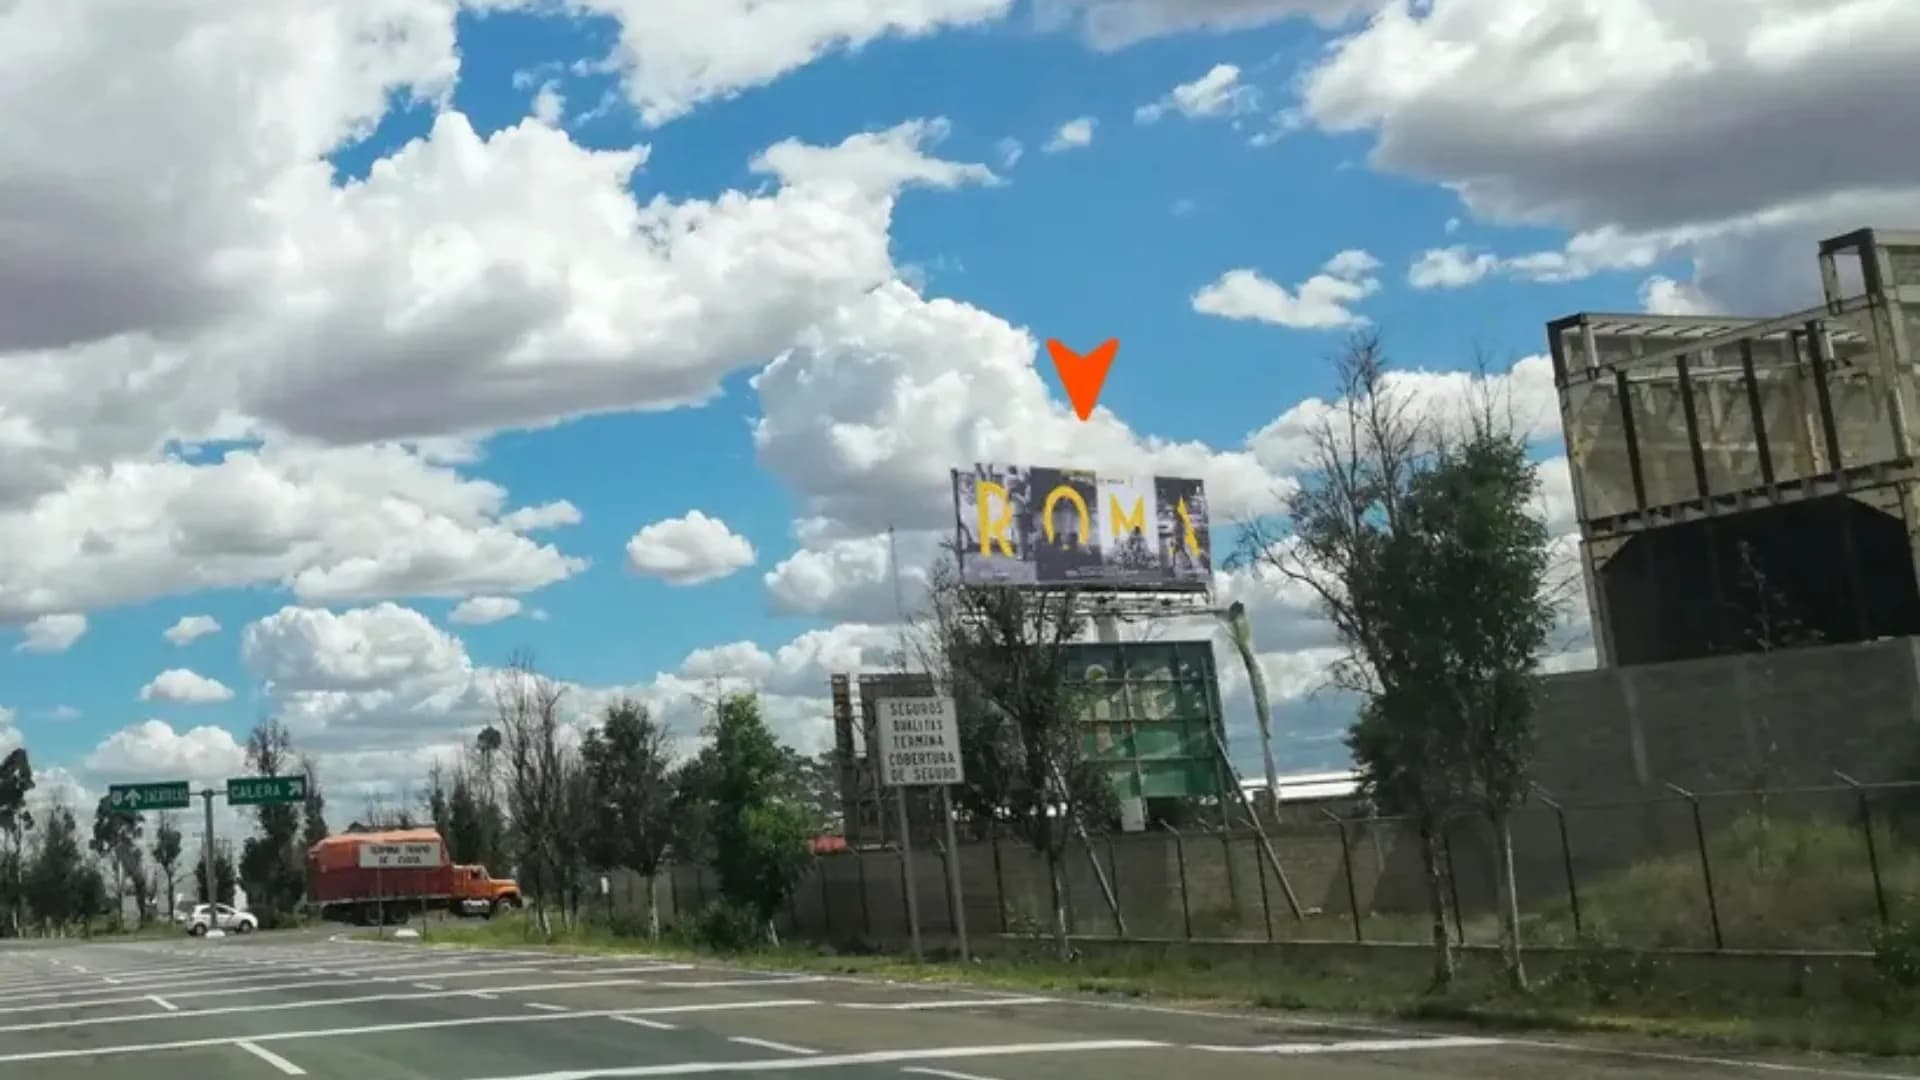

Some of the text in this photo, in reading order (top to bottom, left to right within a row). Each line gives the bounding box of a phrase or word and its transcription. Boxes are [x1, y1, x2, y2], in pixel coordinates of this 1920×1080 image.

[890, 702, 943, 717] SEGUROS
[893, 735, 944, 749] TERMINA
[888, 751, 955, 767] COBERTURA
[891, 766, 957, 782] DE SEGURO
[231, 786, 281, 799] CALERA
